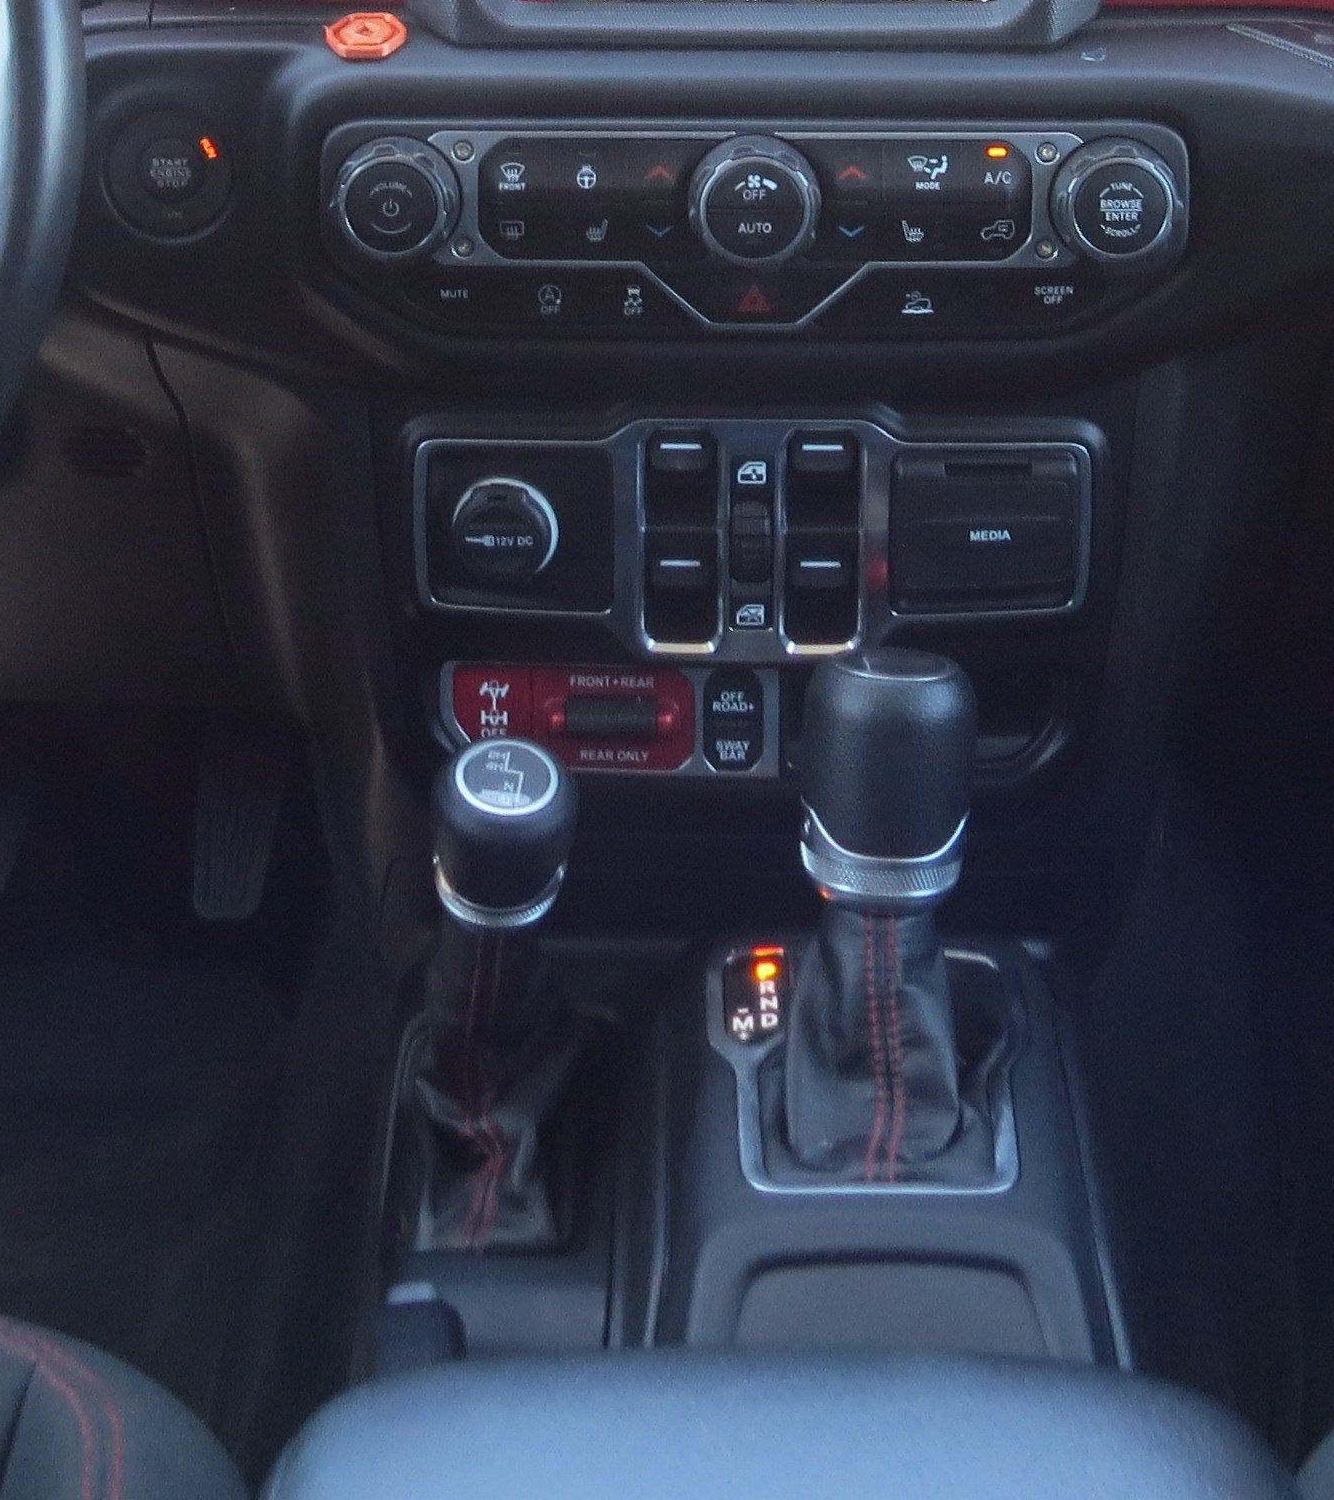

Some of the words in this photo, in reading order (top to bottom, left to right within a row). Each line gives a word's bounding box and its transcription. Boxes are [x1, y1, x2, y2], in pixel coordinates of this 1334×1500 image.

[983, 171, 1014, 184] A/C
[499, 181, 526, 191] FRONT
[915, 182, 940, 190] MODE
[742, 189, 766, 200] OFF
[1099, 199, 1143, 209] BROWSE
[1105, 211, 1139, 221] ENTER
[738, 222, 772, 233] AUTO
[440, 288, 468, 299] MUTE
[1034, 286, 1074, 296] SCREEN
[1043, 296, 1063, 304] OFF
[495, 535, 514, 546] 12V
[517, 535, 534, 546] DC
[969, 529, 1011, 541] MEDIA
[720, 692, 744, 703] OFF
[716, 740, 750, 752] SWAY
[580, 749, 614, 761] REAR
[617, 750, 649, 762] ONLY
[720, 751, 746, 762] BAR
[759, 981, 776, 995] R
[760, 996, 778, 1011] N
[732, 1015, 754, 1031] M
[761, 1013, 779, 1028] D
